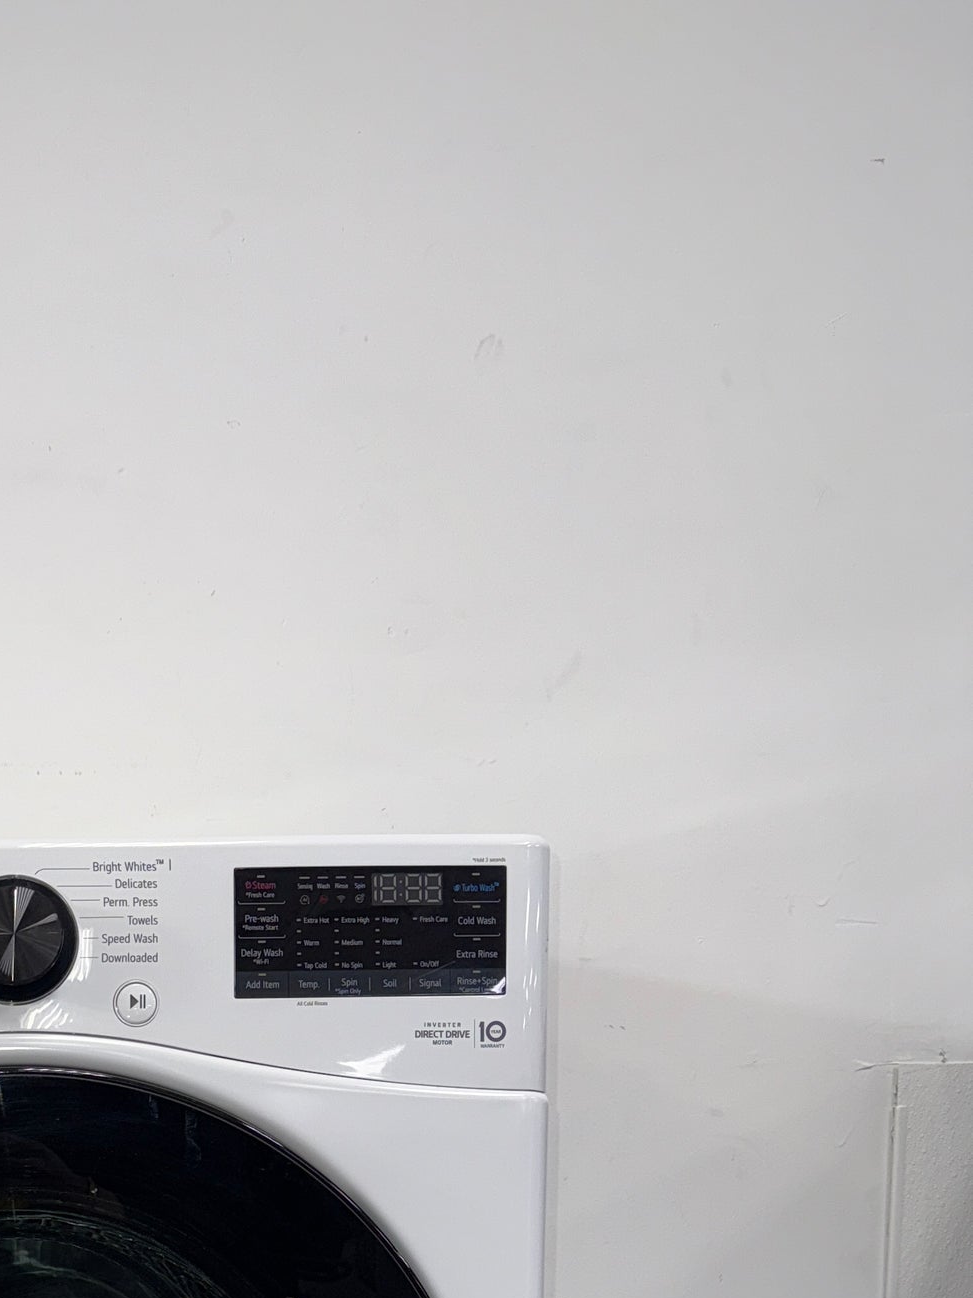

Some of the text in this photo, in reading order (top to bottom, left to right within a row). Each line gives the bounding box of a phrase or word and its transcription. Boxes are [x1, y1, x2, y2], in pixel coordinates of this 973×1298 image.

[92, 861, 122, 875] Bright
[115, 878, 158, 889] Delicates
[252, 881, 276, 890] Steam
[462, 884, 478, 892] Turbo
[103, 896, 158, 907] Perm. Press
[127, 915, 159, 926] Towels
[244, 914, 279, 923] Pre-wash
[382, 916, 399, 924] Heavy
[458, 916, 497, 925] Cold Wash
[101, 933, 159, 946] Speed Wash
[101, 952, 158, 963] Downloaded
[240, 948, 284, 959] Delay Wash
[456, 950, 498, 958] Extra Rinse
[304, 962, 314, 970] Tap
[382, 961, 397, 969] Light
[419, 960, 440, 968] On/Off
[246, 980, 280, 989] Add Item
[299, 980, 320, 990] Temp.
[341, 978, 358, 987] Spin
[383, 979, 397, 988] Soil
[419, 978, 442, 990] Signal
[415, 1030, 471, 1039] DIRECT DRIVE
[478, 1020, 507, 1043] 10
